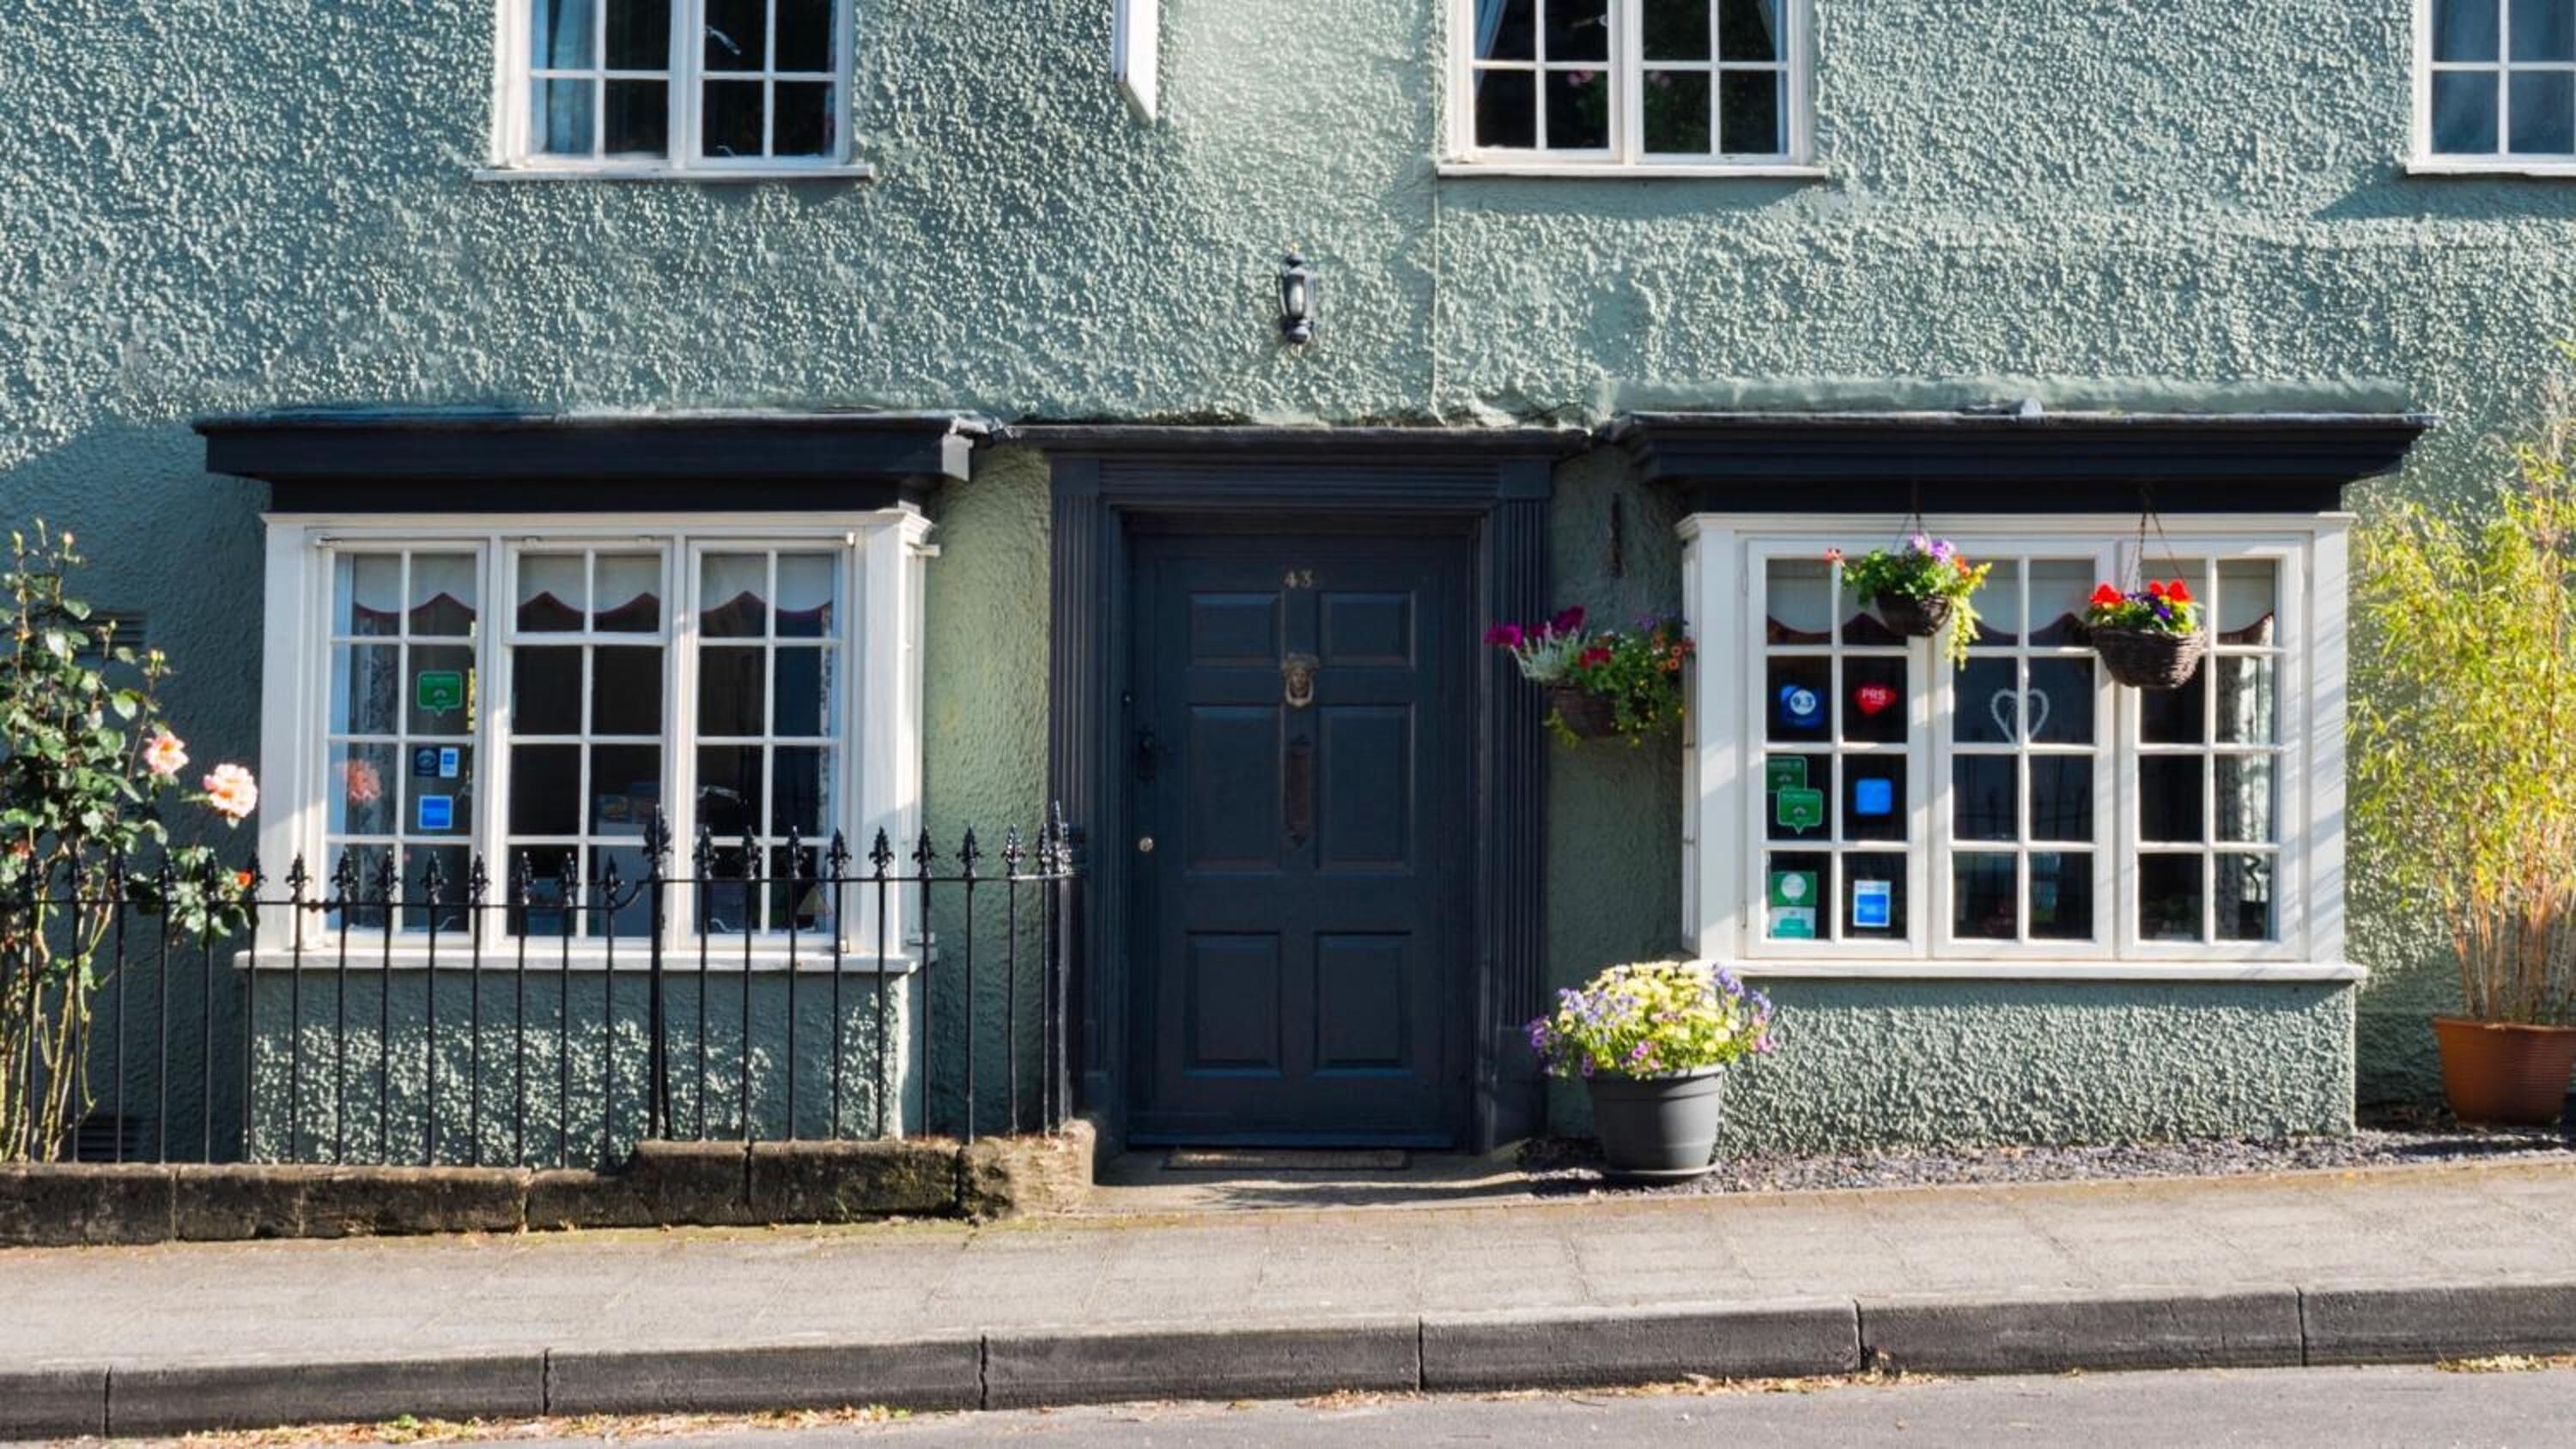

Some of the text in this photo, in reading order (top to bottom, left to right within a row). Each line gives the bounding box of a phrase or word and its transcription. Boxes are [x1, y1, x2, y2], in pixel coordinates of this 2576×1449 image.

[1284, 569, 1314, 589] 43
[1793, 694, 1814, 709] 9.3
[1862, 688, 1886, 700] PRS
